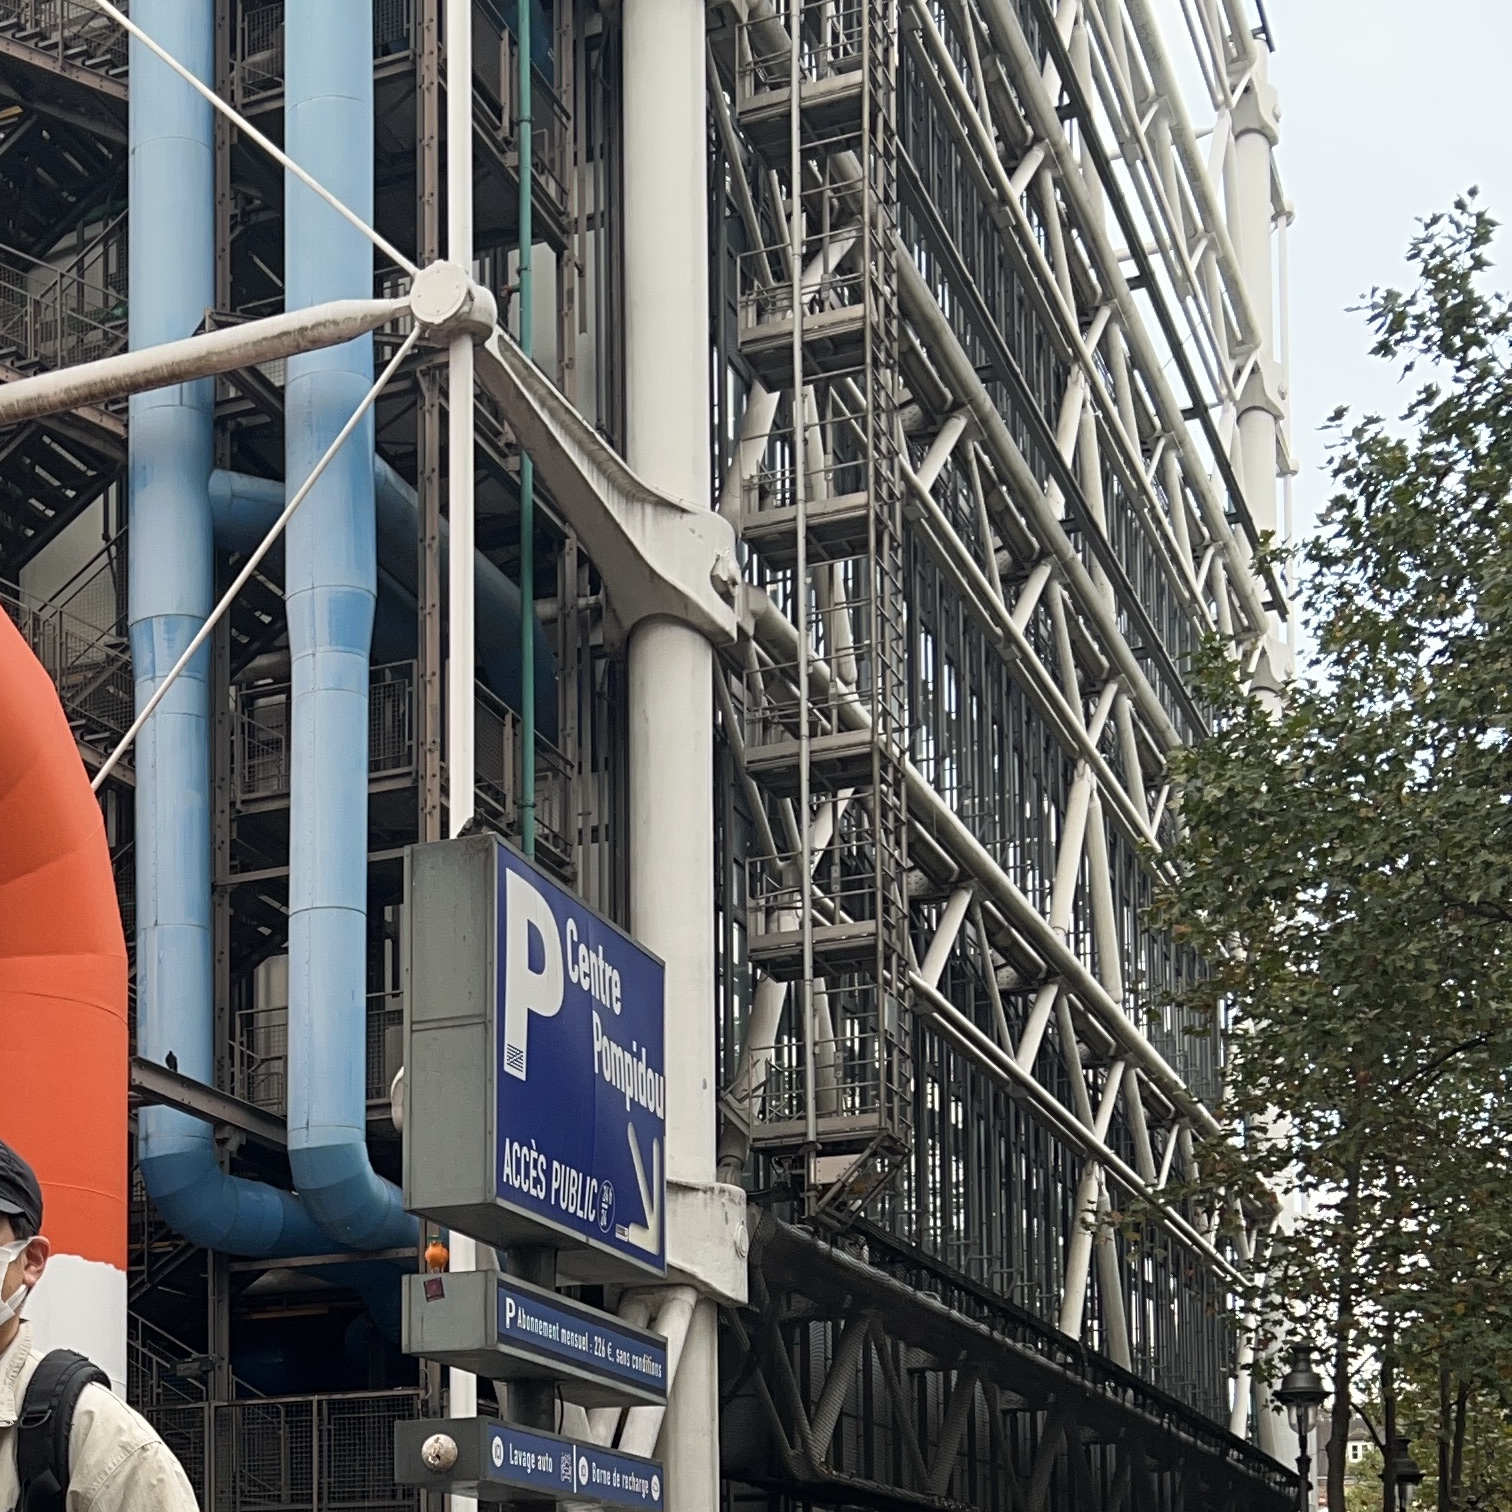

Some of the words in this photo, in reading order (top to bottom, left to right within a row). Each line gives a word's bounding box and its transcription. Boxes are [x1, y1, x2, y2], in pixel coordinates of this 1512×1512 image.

[504, 867, 565, 1081] P
[566, 917, 622, 1016] Centre
[592, 1010, 665, 1120] Pompidou
[503, 1137, 547, 1200] ACCÈS
[551, 1160, 598, 1222] PUBLIC
[505, 1296, 516, 1329] P
[517, 1306, 560, 1342] Abonnement
[560, 1328, 589, 1353] mensuel
[616, 1348, 631, 1367] sans
[509, 1442, 536, 1474] Lavage
[537, 1452, 553, 1473] auto
[591, 1461, 611, 1486] Borne
[612, 1466, 621, 1488] de
[621, 1471, 649, 1499] recharge
